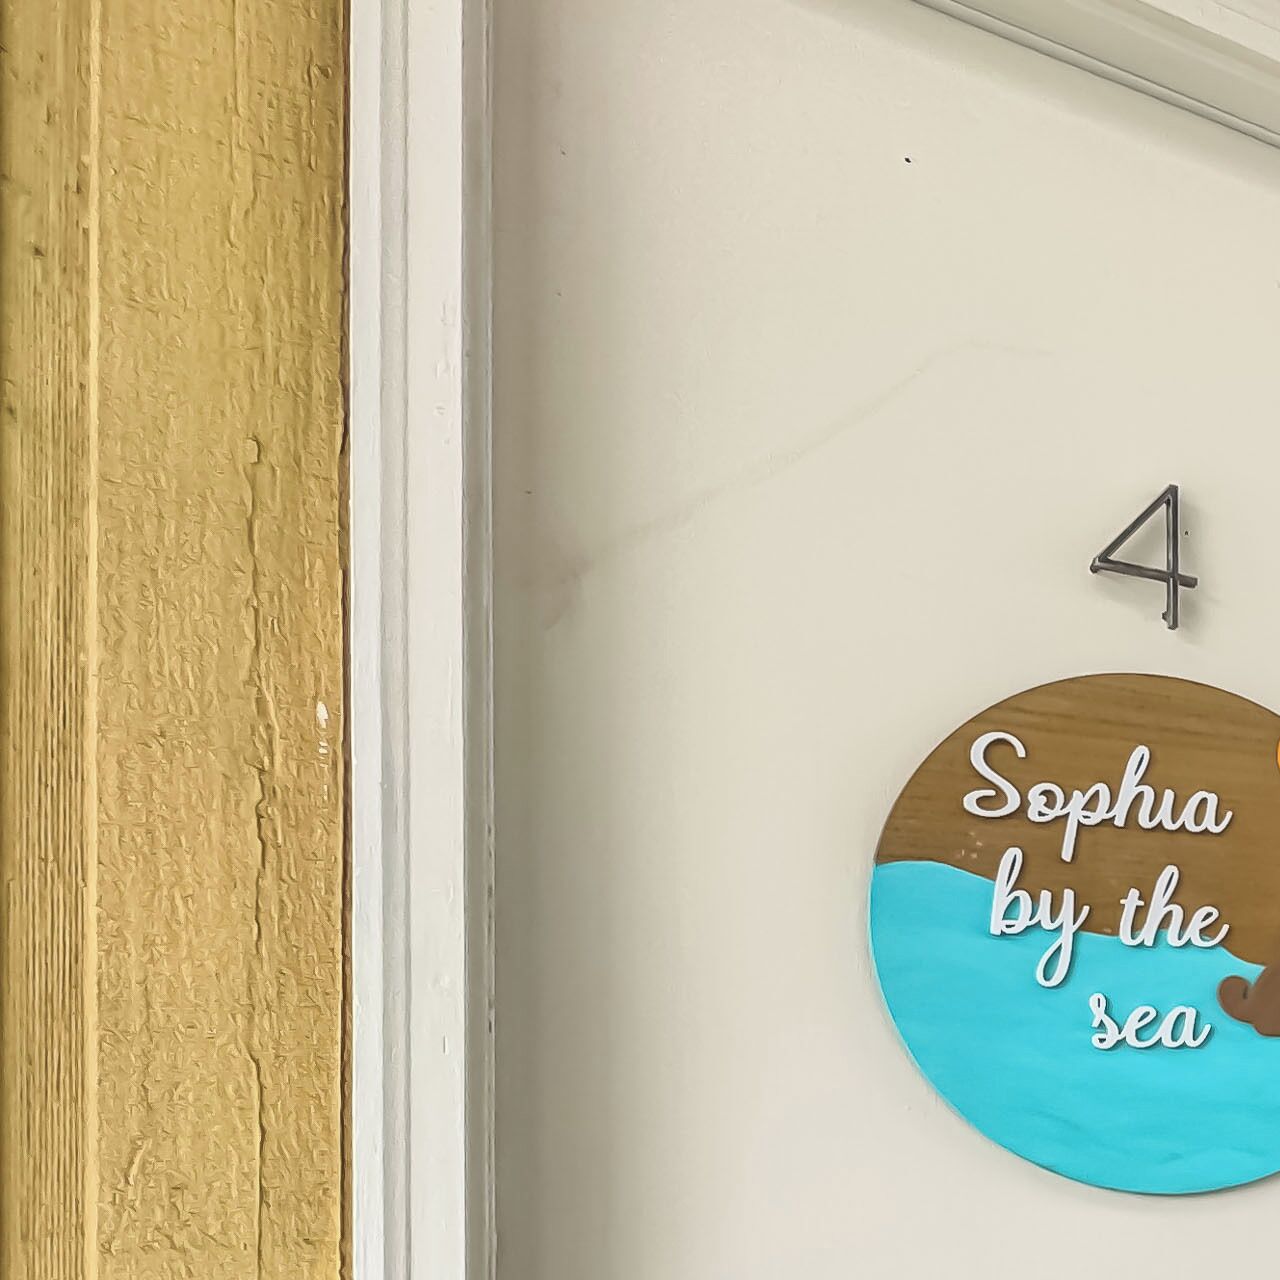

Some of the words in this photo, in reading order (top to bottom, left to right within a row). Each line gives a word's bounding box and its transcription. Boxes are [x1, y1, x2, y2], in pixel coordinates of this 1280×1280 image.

[1088, 484, 1199, 631] 4
[963, 731, 1233, 862] Sophia
[989, 847, 1090, 988] by
[1119, 864, 1230, 947] the
[1088, 992, 1212, 1050] sea
